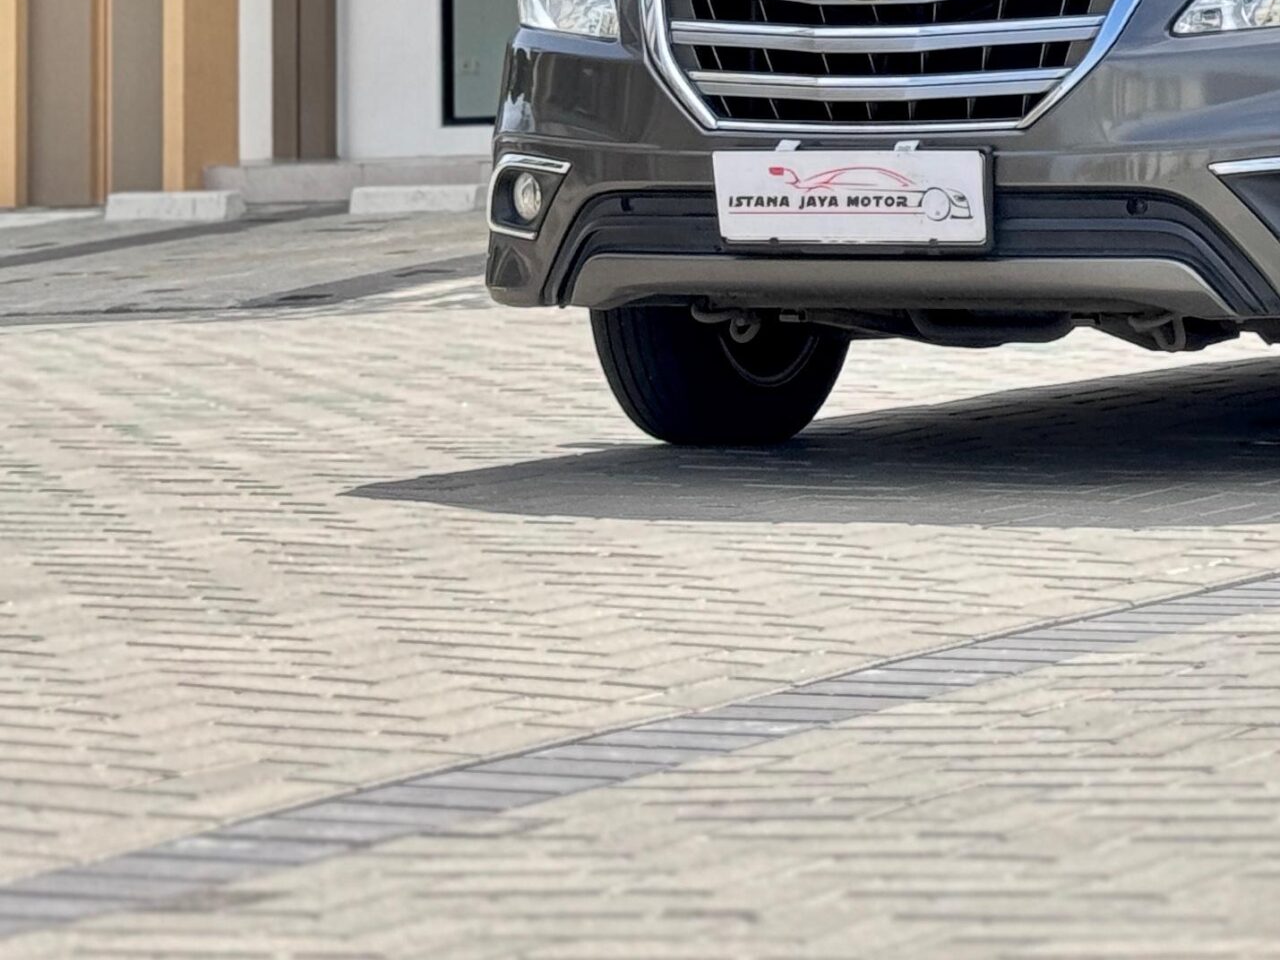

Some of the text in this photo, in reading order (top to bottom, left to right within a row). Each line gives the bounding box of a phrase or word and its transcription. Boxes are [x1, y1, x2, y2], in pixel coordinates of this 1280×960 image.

[729, 196, 908, 210] ISTANA JAYA MOTOR
